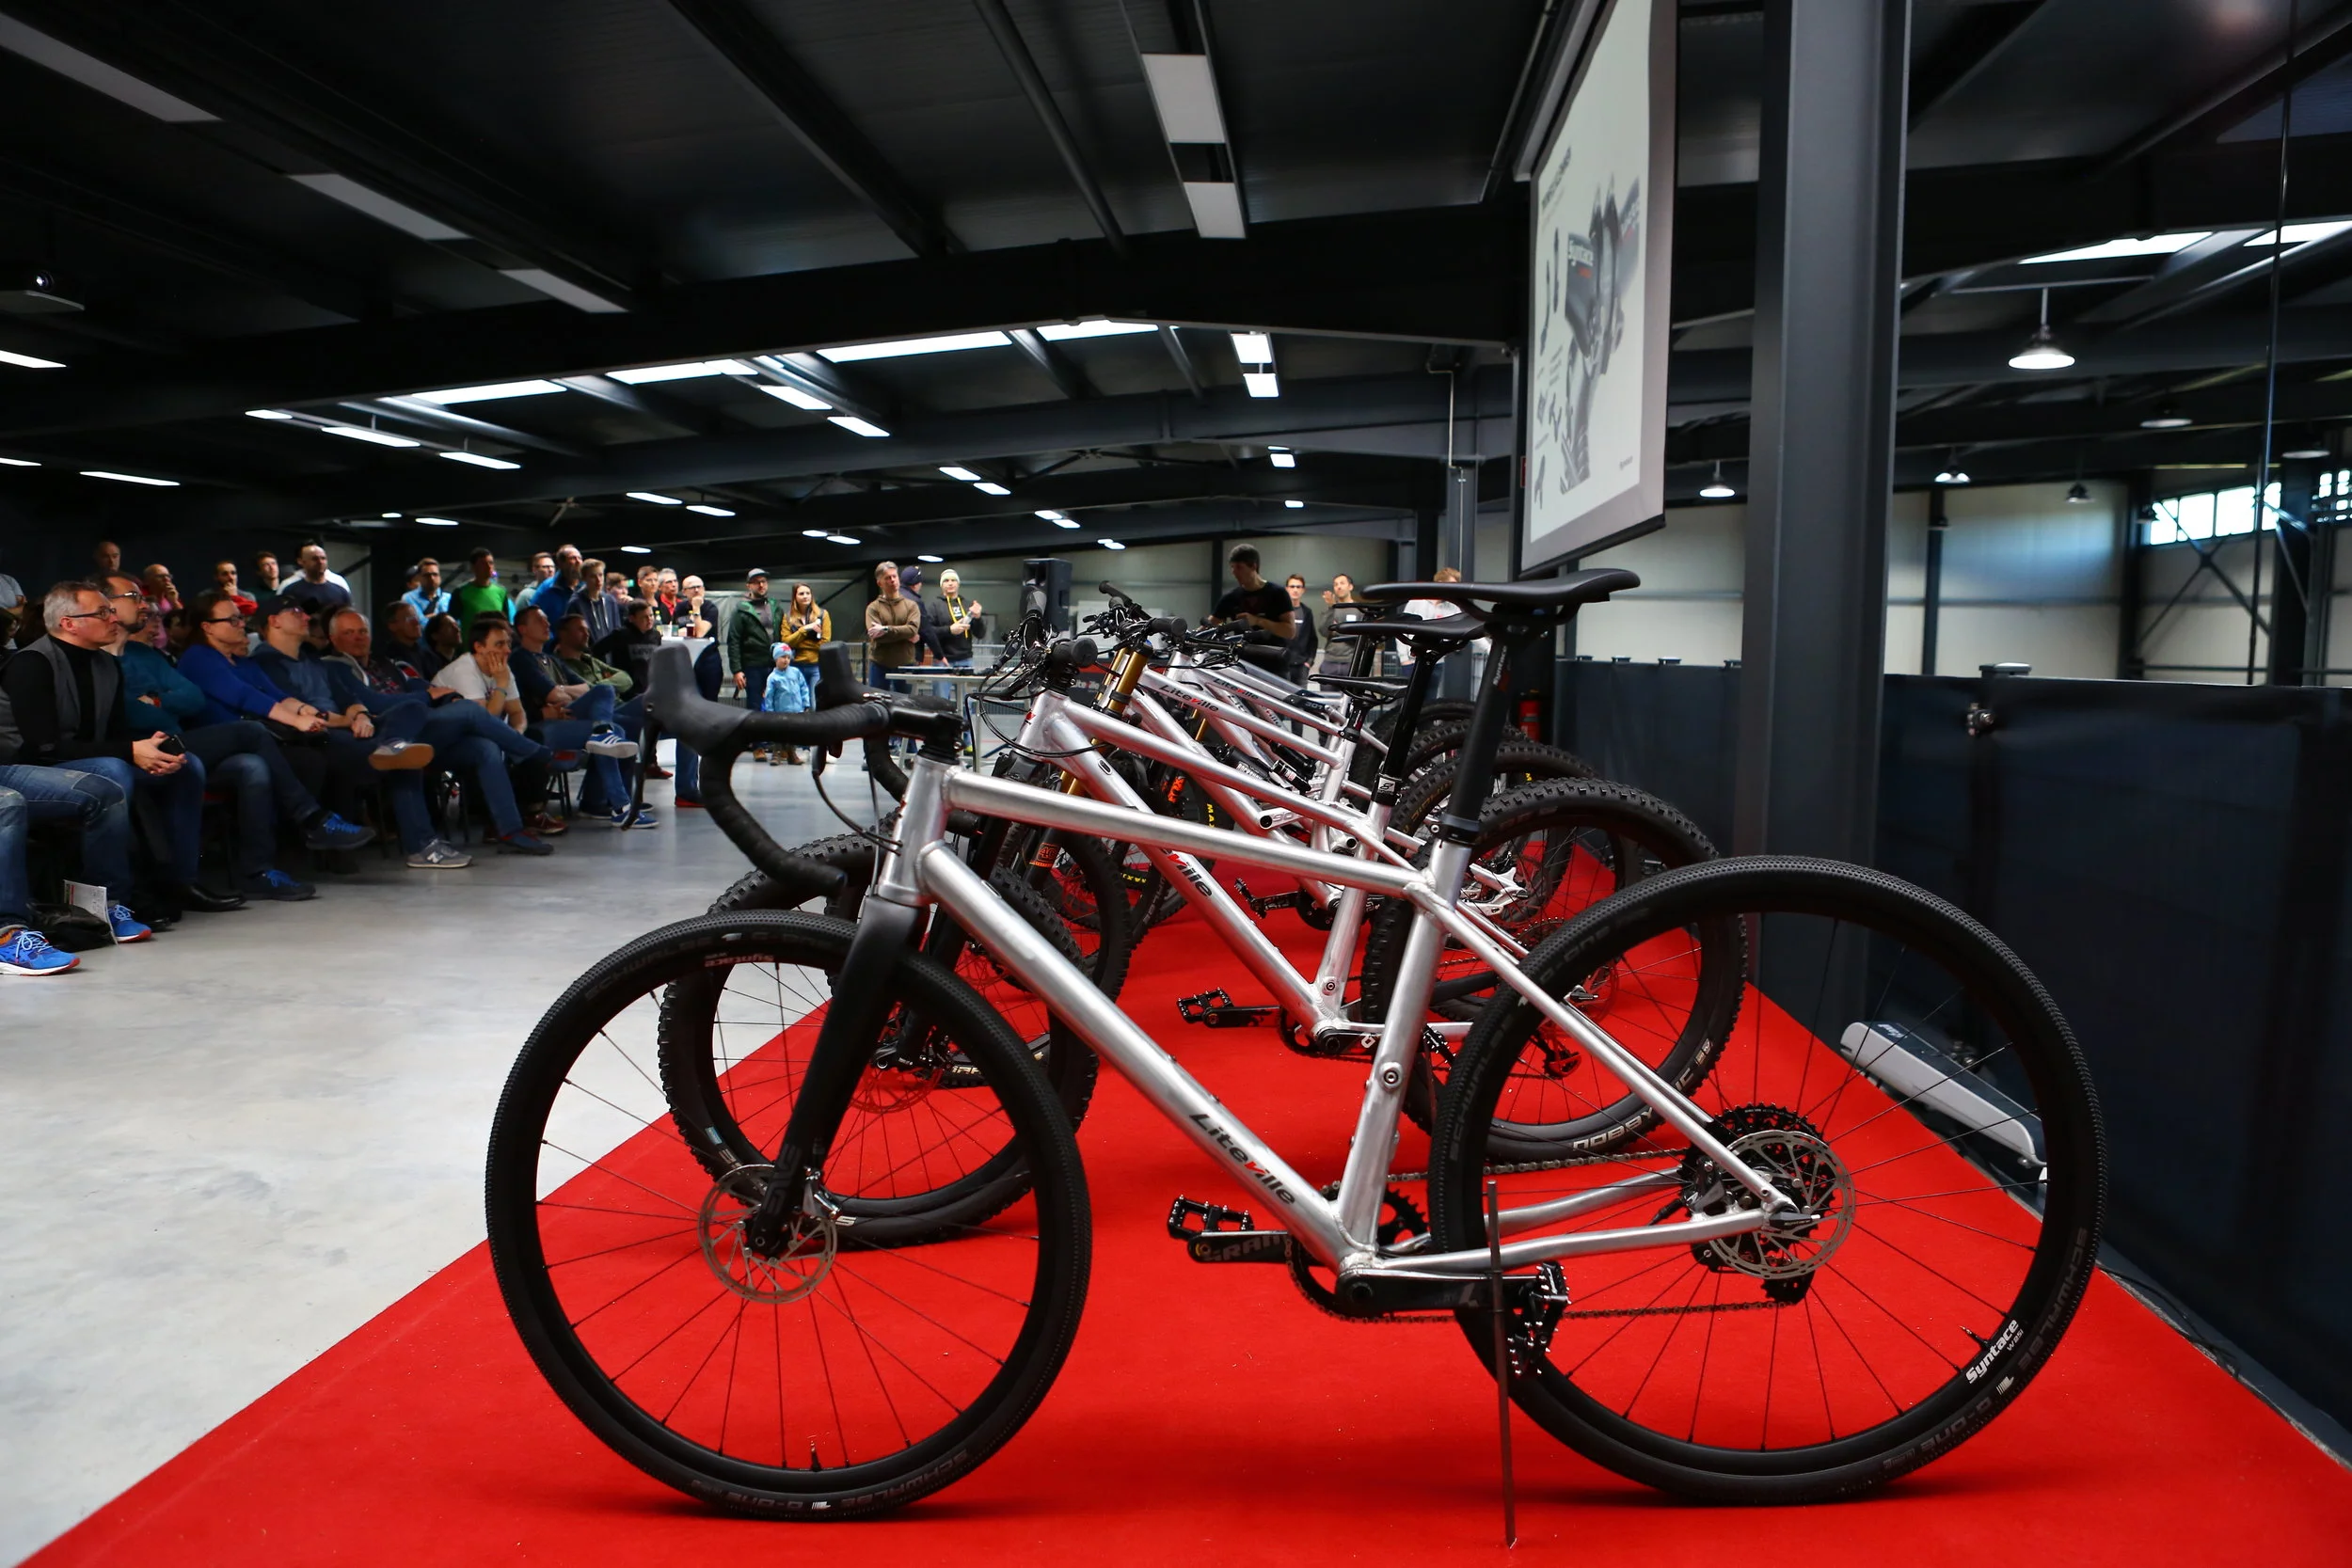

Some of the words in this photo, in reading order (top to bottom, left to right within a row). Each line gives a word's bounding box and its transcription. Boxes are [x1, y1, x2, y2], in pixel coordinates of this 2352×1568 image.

[1159, 685, 1219, 712] Liteville
[1214, 677, 1259, 701] Liteville
[1189, 1114, 1295, 1204] Liteville
[2015, 1227, 2088, 1370] SCHWALBE
[1965, 1319, 2019, 1384] Syntace
[840, 1448, 970, 1508] SCHWALBE
